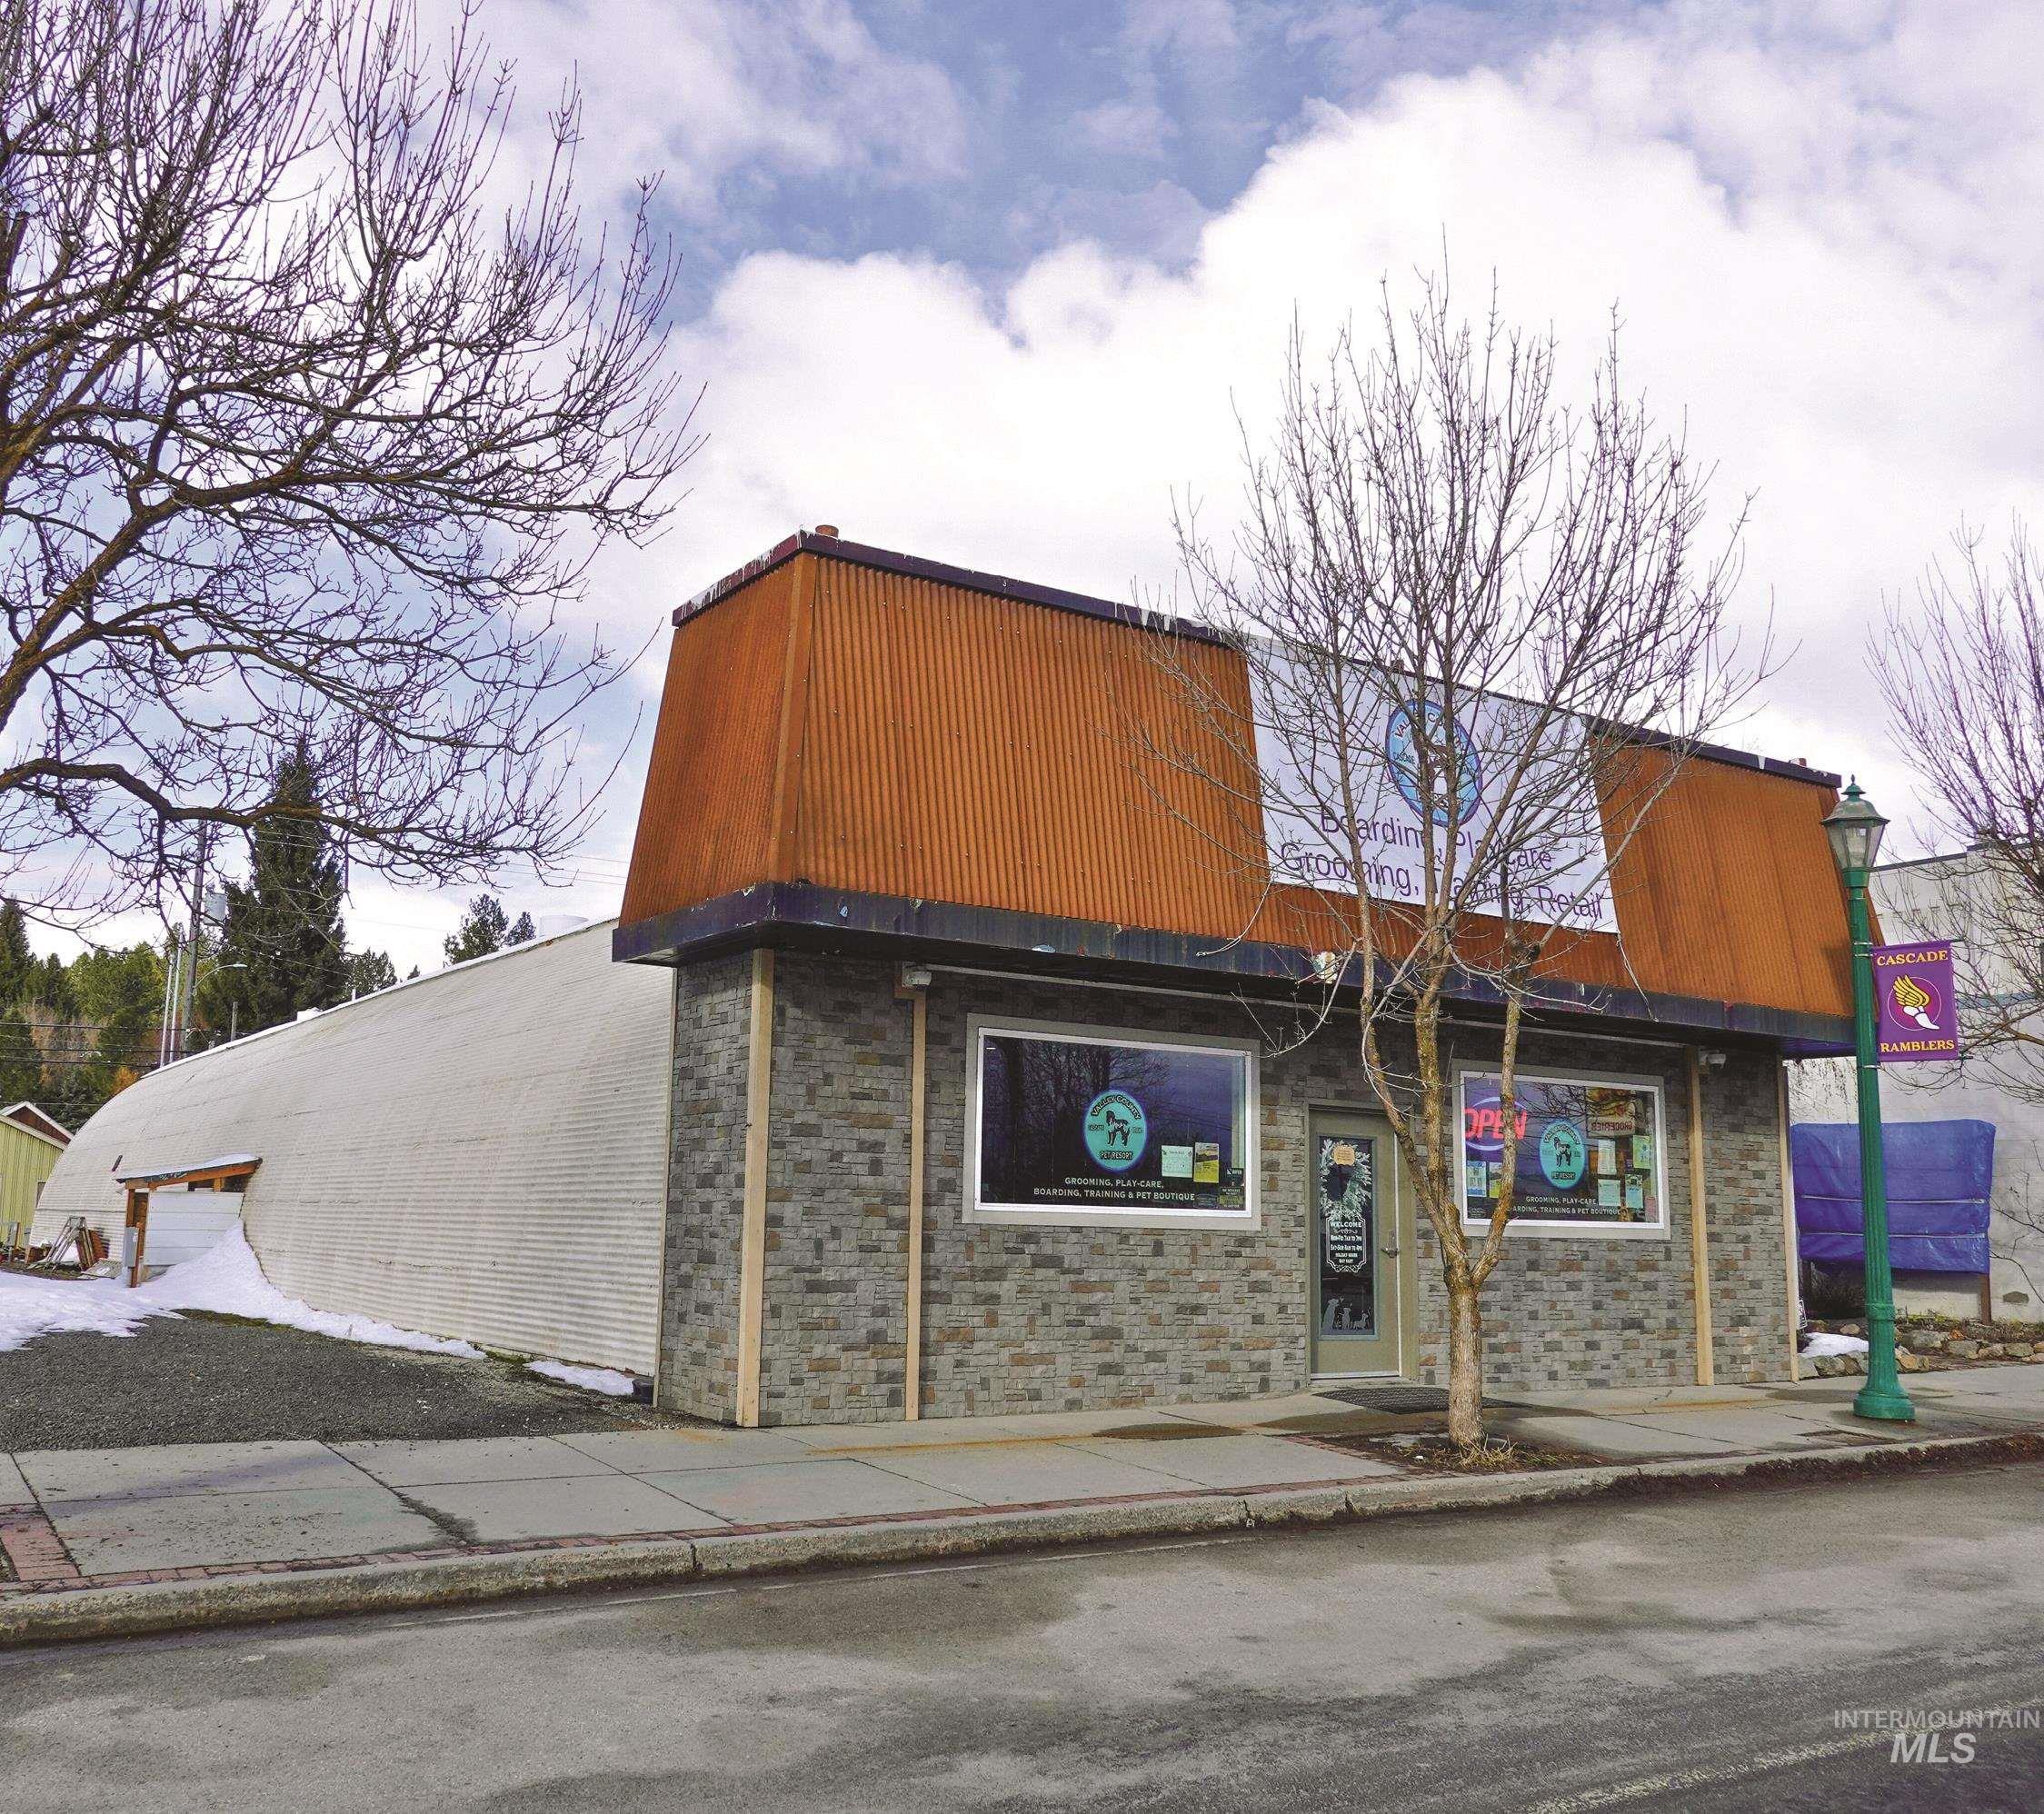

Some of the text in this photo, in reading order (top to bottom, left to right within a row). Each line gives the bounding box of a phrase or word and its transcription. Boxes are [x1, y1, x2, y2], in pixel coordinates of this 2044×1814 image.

[1321, 805, 1442, 857] Boardin,
[1281, 842, 1419, 896] Grooming,
[1538, 885, 1602, 919] Retail
[1877, 951, 1949, 965] CASCADE
[1880, 1040, 1955, 1052] RAMBLERS
[1092, 1095, 1142, 1120] VALLEY COUNTY
[1464, 1108, 1527, 1140] OPEN
[1101, 1151, 1133, 1161] PET RESORT
[1064, 1177, 1164, 1189] GROOMING, PLAY-CARE,
[1033, 1188, 1082, 1197] BOARDING,
[1084, 1190, 1126, 1199] TRAINING
[1136, 1191, 1152, 1200] PET
[1153, 1191, 1195, 1201] BOUTIQUE
